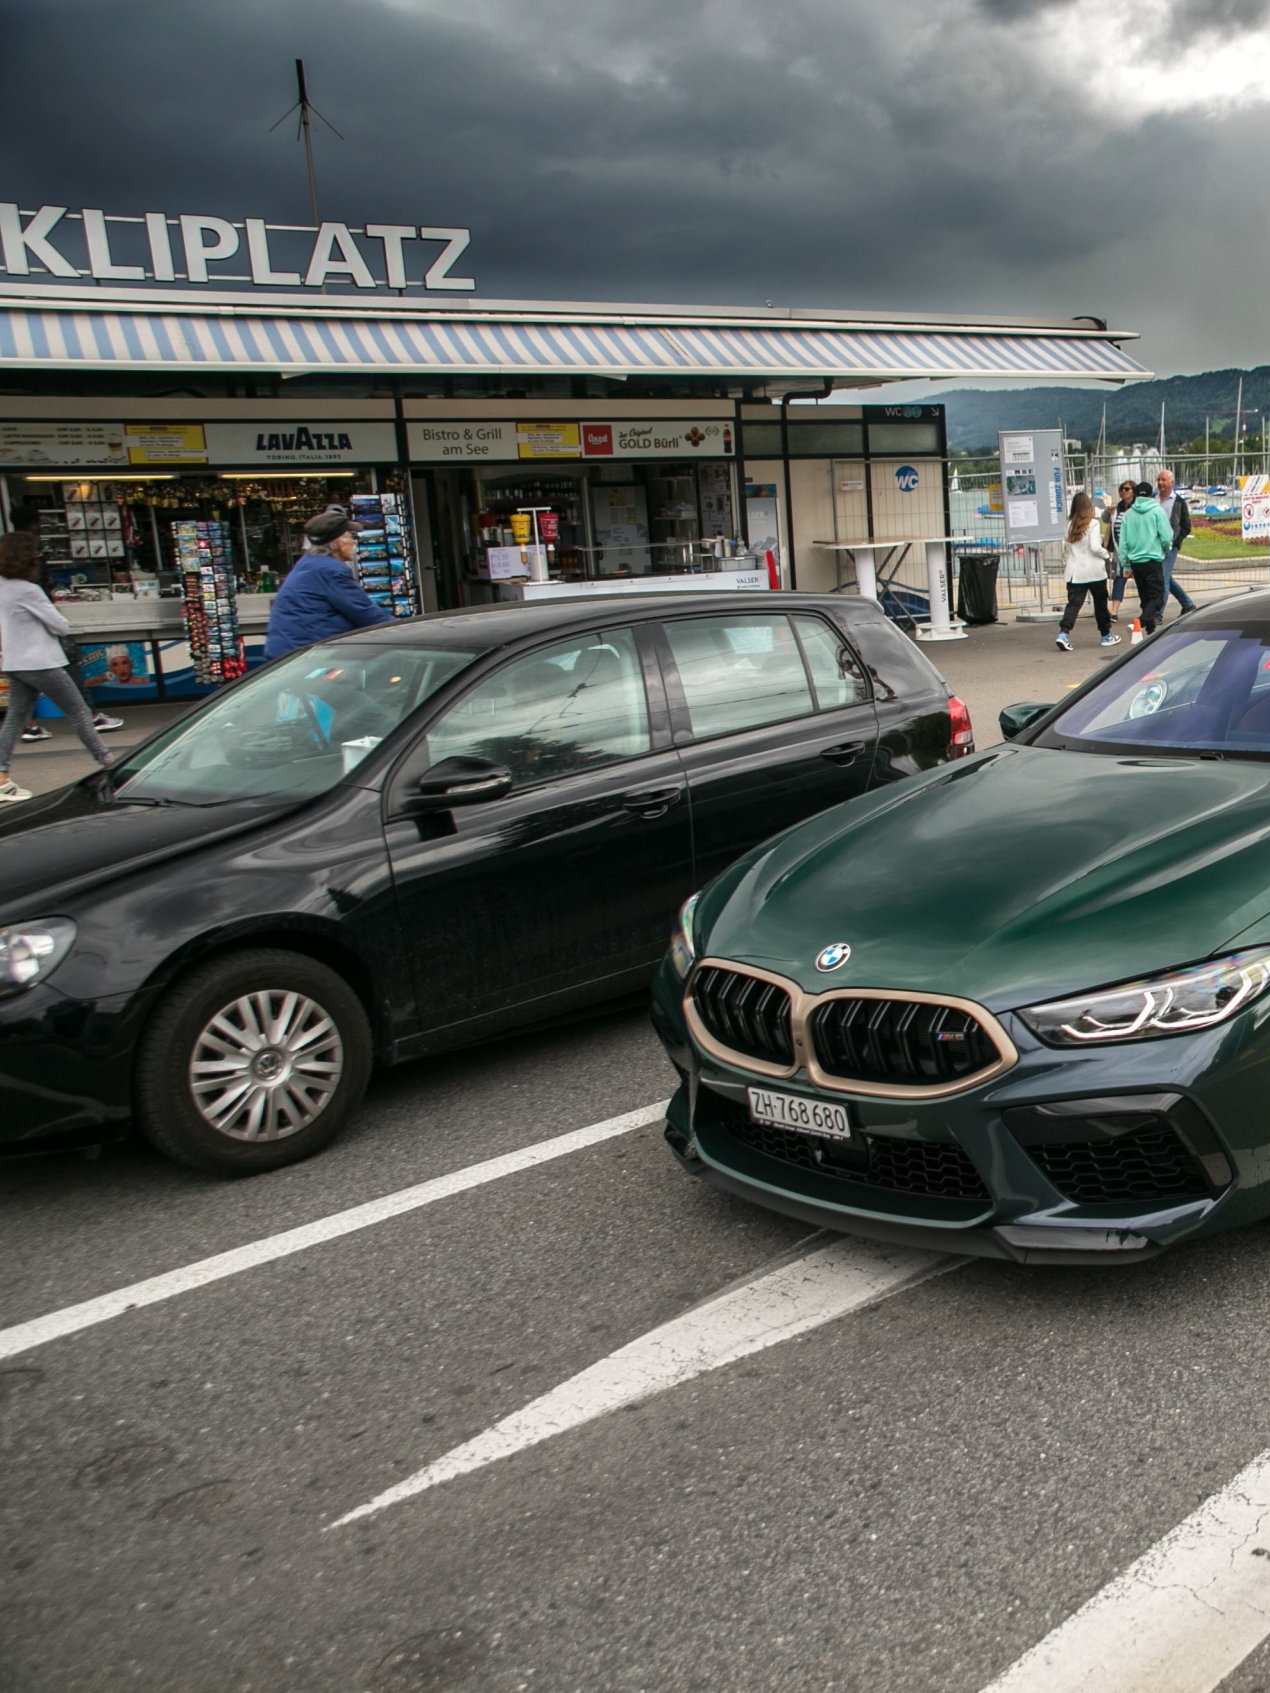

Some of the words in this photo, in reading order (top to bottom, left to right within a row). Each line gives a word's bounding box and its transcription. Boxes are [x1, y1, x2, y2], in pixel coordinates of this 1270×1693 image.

[885, 407, 902, 417] WC
[256, 427, 353, 451] LAVAZZA
[423, 428, 460, 441] Bistro
[463, 429, 473, 440] &
[476, 428, 502, 440] Grill
[442, 446, 463, 455] am
[466, 443, 489, 455] See
[619, 438, 651, 449] GOLD
[896, 475, 919, 489] WC
[1053, 467, 1061, 483] FÜR
[1055, 484, 1063, 513] ZÜRICH
[939, 574, 948, 603] VALSER
[776, 1096, 810, 1125] 768
[812, 1104, 846, 1132] 680
